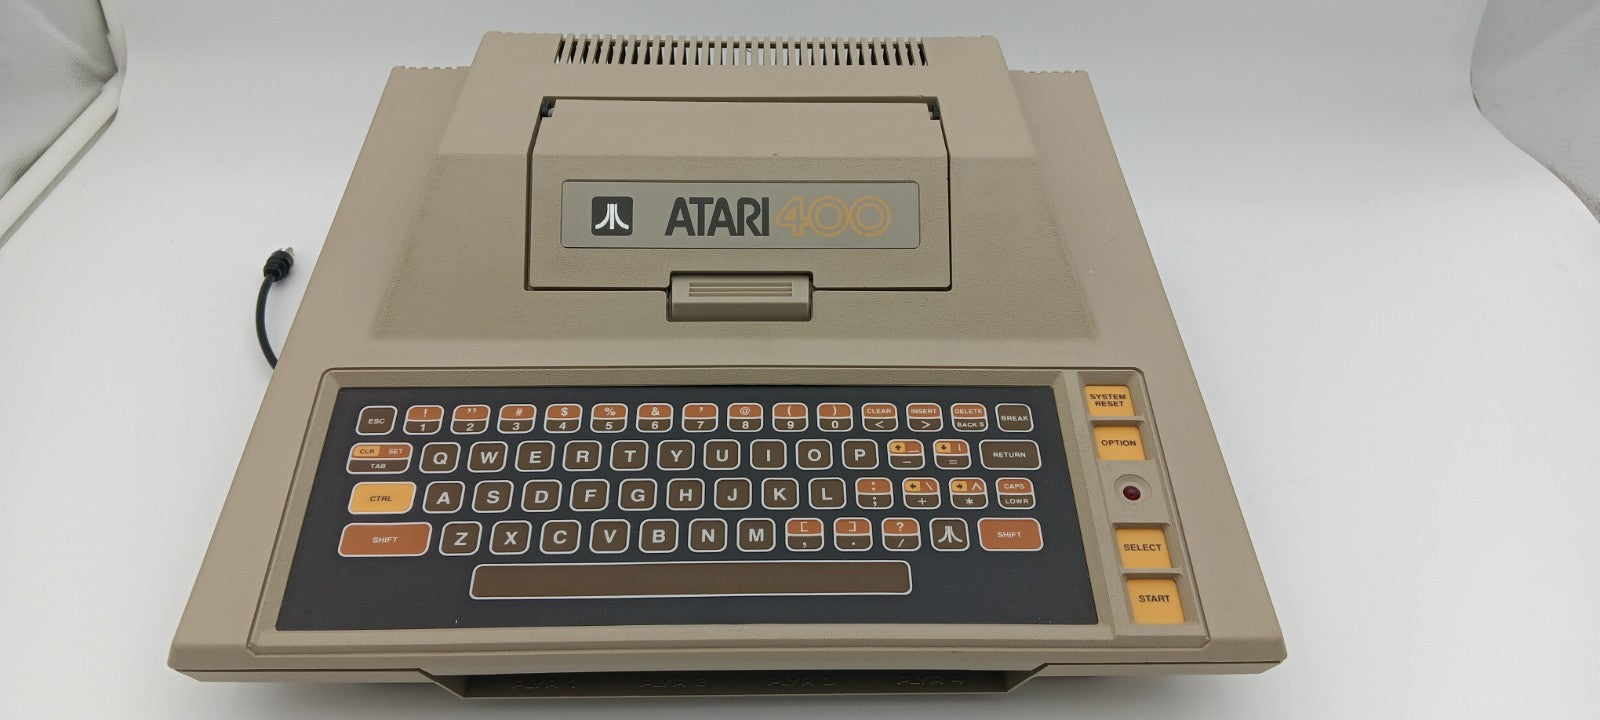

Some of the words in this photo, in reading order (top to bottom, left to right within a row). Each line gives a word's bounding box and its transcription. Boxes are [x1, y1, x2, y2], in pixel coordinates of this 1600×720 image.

[665, 196, 770, 236] ATARI
[774, 196, 892, 238] 400
[424, 408, 428, 418] !
[515, 408, 523, 416] #
[560, 406, 568, 416] $
[604, 406, 616, 416] %
[652, 406, 660, 416] &
[740, 406, 750, 416] @
[788, 405, 792, 416] (
[832, 406, 836, 416] )
[420, 424, 426, 432] 1
[466, 422, 475, 432] 2
[512, 422, 520, 430] 3
[558, 421, 566, 430] 4
[606, 422, 612, 430] 5
[652, 420, 660, 430] 6
[696, 420, 704, 430] 7
[742, 420, 750, 430] 8
[786, 420, 794, 430] 9
[832, 420, 838, 428] 0
[874, 420, 884, 428] <
[922, 420, 930, 428] >
[432, 452, 448, 464] Q
[480, 452, 498, 464] W
[530, 450, 542, 464] E
[576, 450, 590, 462] R
[624, 450, 636, 462] T
[670, 450, 682, 462] Y
[716, 450, 728, 462] U
[766, 450, 770, 462] I
[808, 448, 822, 462] O
[854, 448, 866, 462] P
[436, 492, 450, 504] A
[486, 490, 500, 504] S
[534, 490, 548, 504] D
[584, 488, 598, 502] F
[630, 488, 646, 502] G
[680, 488, 692, 502] H
[728, 488, 738, 502] J
[774, 488, 786, 500] K
[822, 488, 832, 500] L
[918, 498, 926, 506] +
[800, 522, 808, 532] [
[848, 522, 856, 532] ]
[896, 522, 904, 532] ?
[454, 532, 468, 546] Z
[504, 532, 518, 546] X
[554, 530, 568, 544] C
[604, 530, 618, 544] V
[652, 528, 666, 544] B
[702, 528, 714, 542] N
[748, 528, 764, 542] M
[898, 538, 904, 548] /
[1124, 544, 1162, 552] SELECT
[1138, 594, 1170, 602] START
